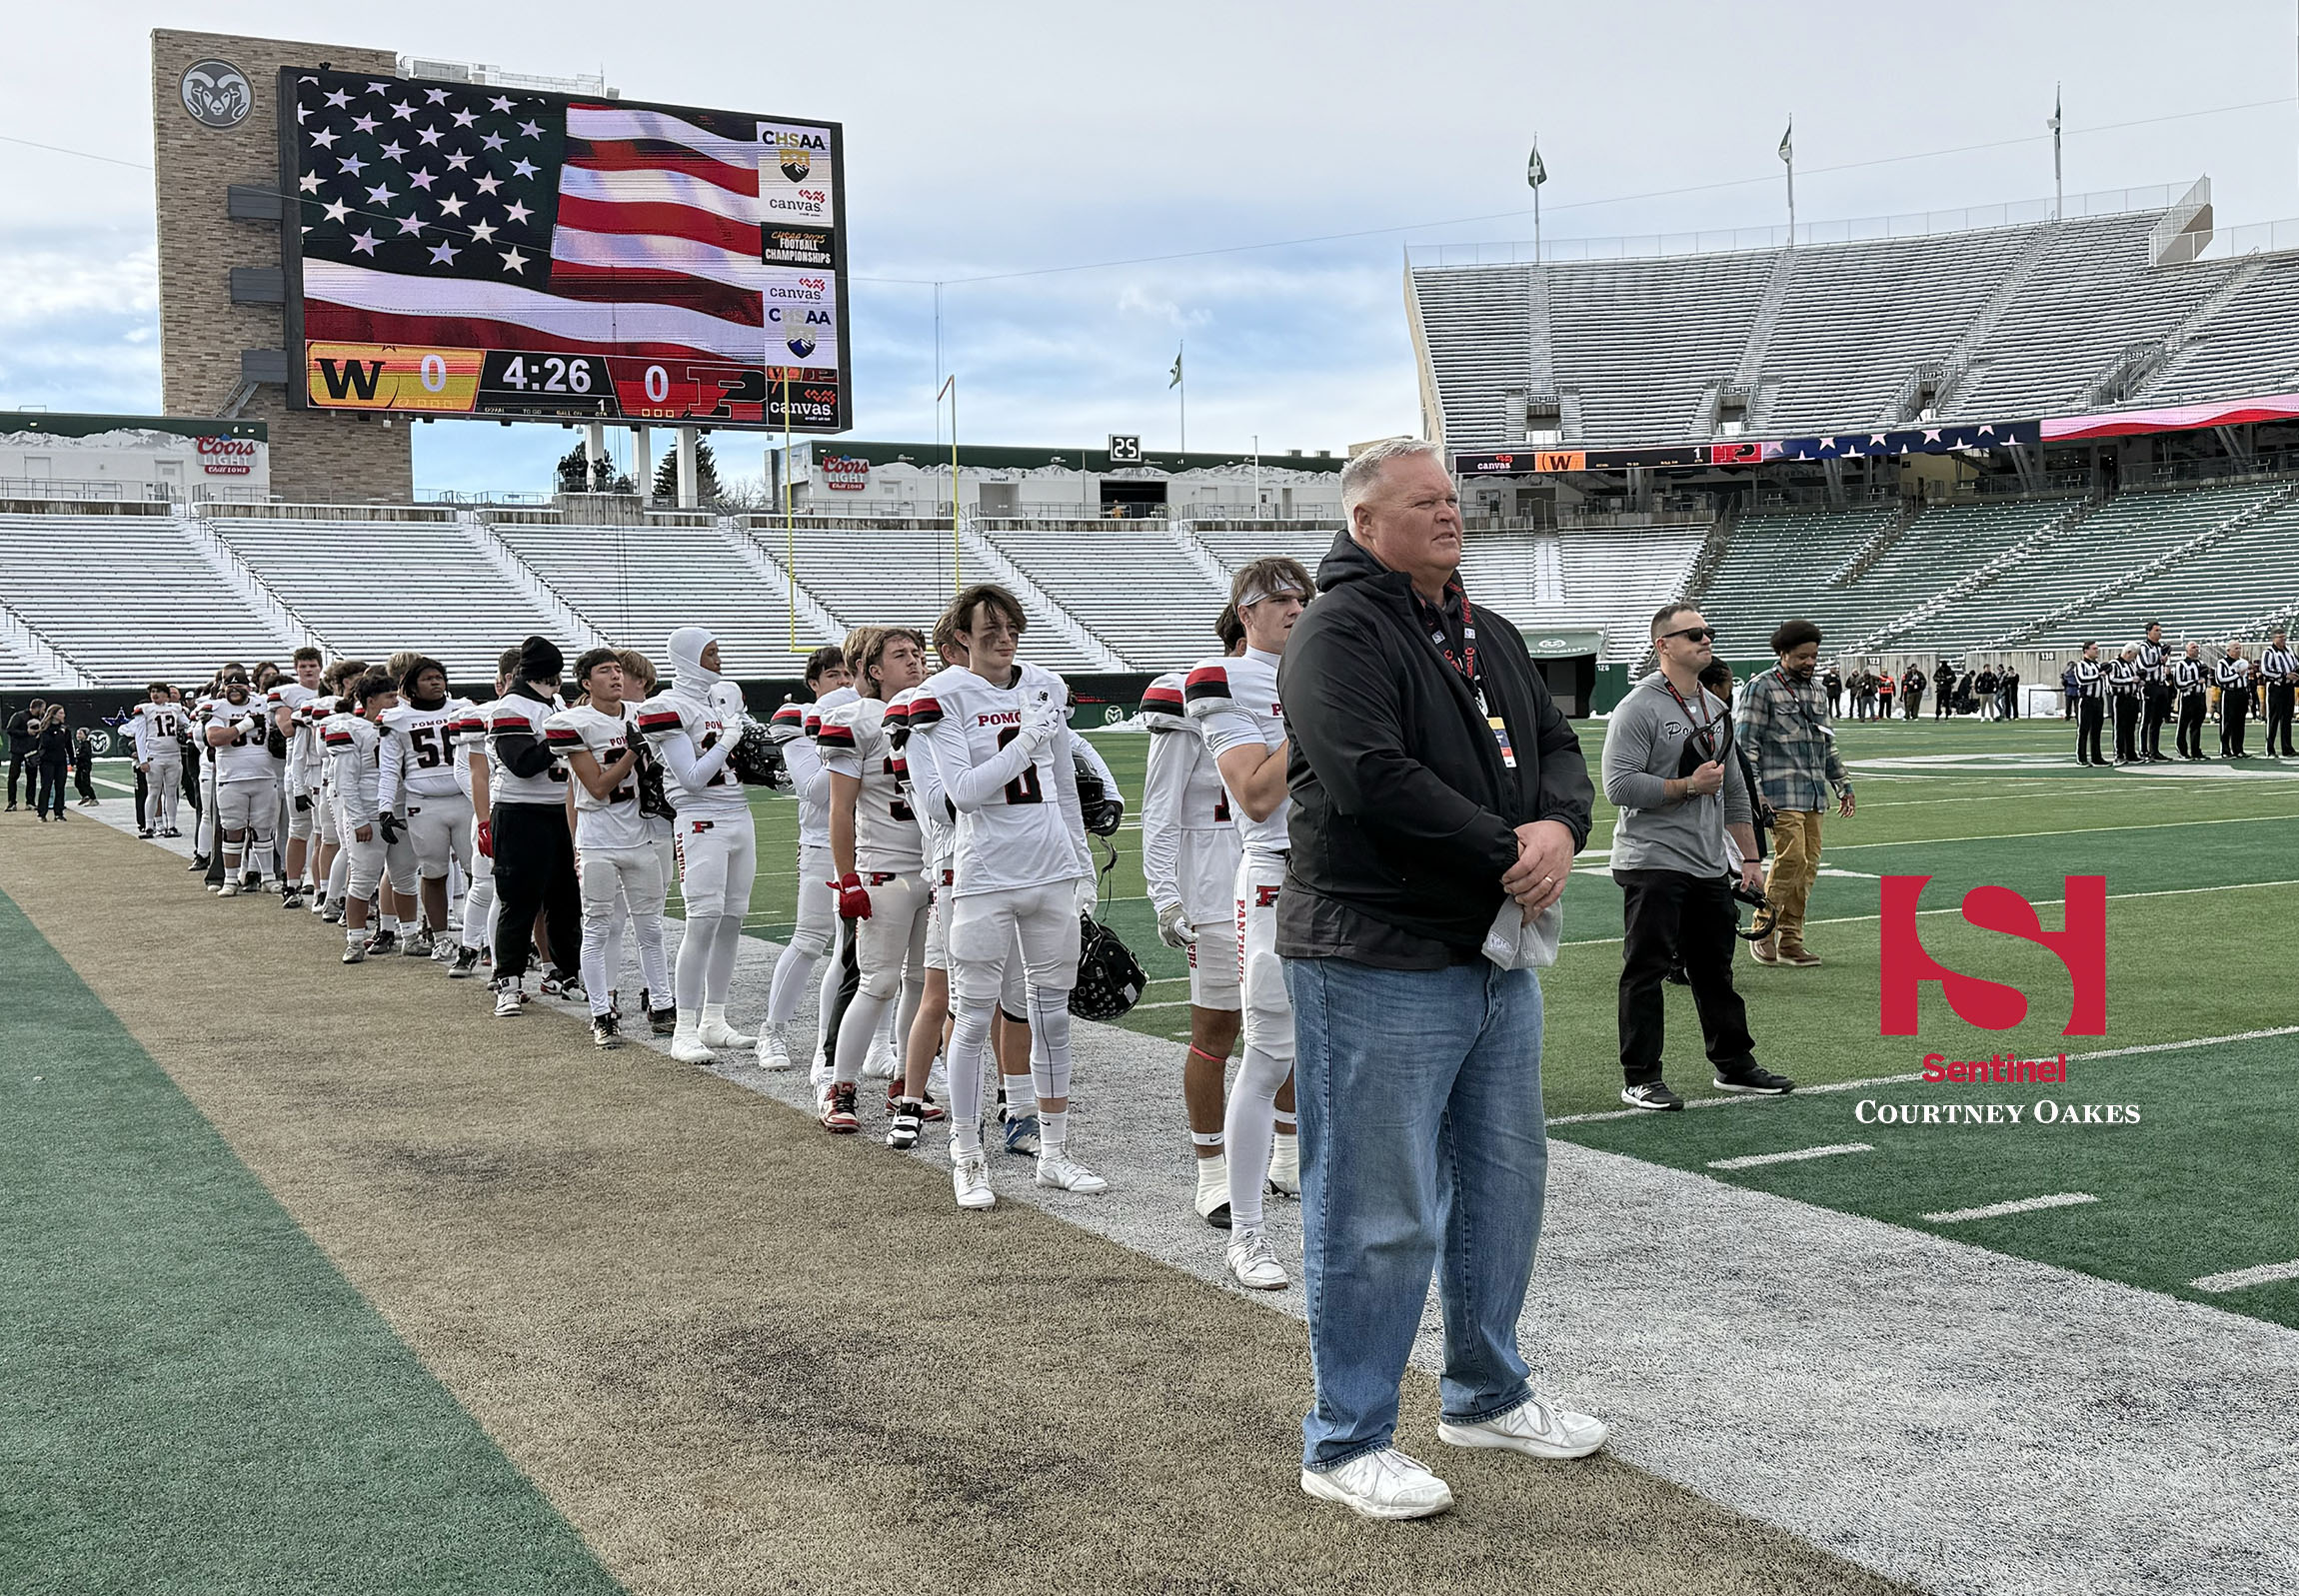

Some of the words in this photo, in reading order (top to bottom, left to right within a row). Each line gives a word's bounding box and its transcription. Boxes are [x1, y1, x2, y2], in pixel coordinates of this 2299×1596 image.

[762, 131, 826, 150] CHSAA
[780, 237, 819, 251] FOOTBALL
[766, 249, 831, 264] CHAMPIONSHIPS
[315, 358, 386, 401] W
[421, 354, 447, 393] 0
[502, 356, 592, 394] 4:26
[645, 365, 669, 403] 0
[687, 366, 767, 418] P
[597, 399, 605, 412] 1
[196, 435, 255, 455] Coors
[1114, 438, 1138, 458] 25
[204, 455, 249, 466] LIGHT
[823, 456, 870, 474] Coors
[1477, 461, 1510, 470] canvas
[1549, 455, 1572, 471] W
[829, 473, 865, 483] LIGHT
[154, 714, 176, 738] 12
[407, 806, 421, 817] P
[692, 820, 715, 834] P
[870, 871, 896, 886] P
